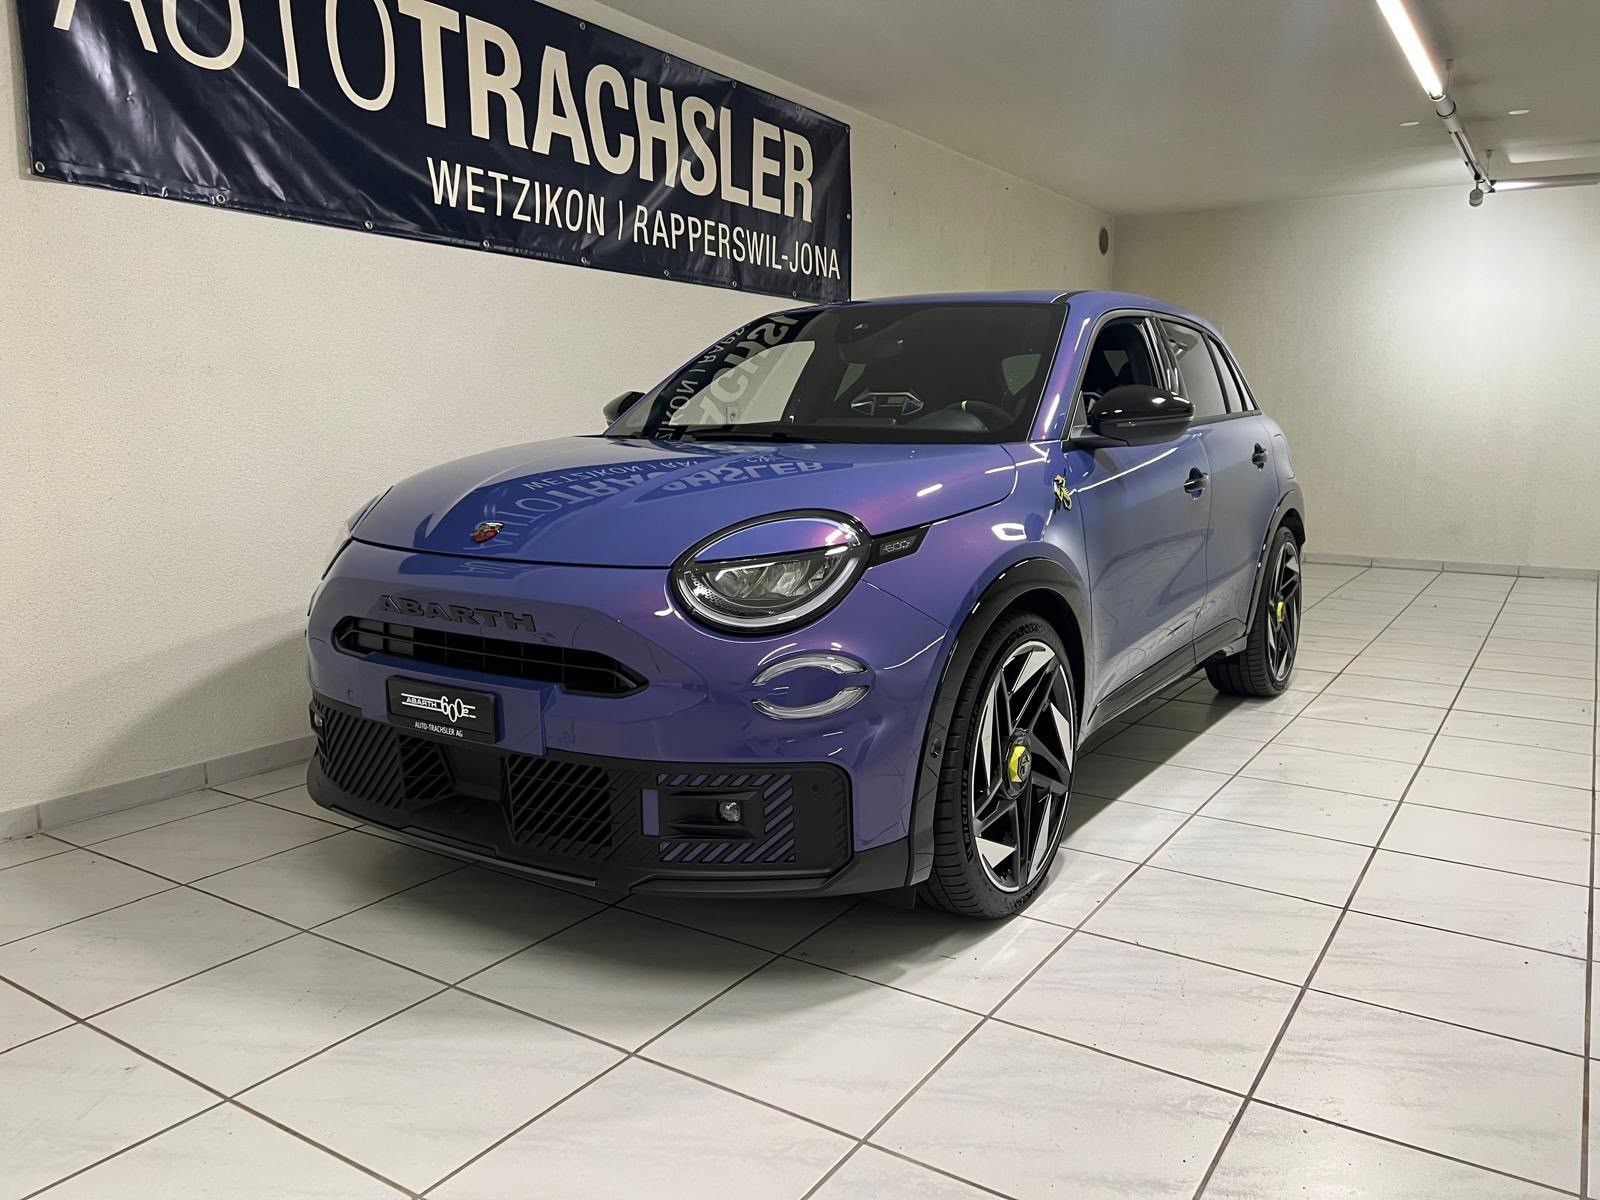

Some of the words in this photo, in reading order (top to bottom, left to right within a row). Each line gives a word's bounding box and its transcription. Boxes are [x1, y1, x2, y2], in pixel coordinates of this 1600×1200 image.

[426, 156, 605, 236] WETZIKON
[633, 204, 841, 280] RAPPERSWIL-JONA
[379, 594, 537, 632] ABARTH
[406, 697, 437, 708] ABARTH
[414, 721, 455, 736] AUTO-TRACHSLER
[456, 729, 464, 738] AG
[961, 769, 971, 843] MICHELIN
